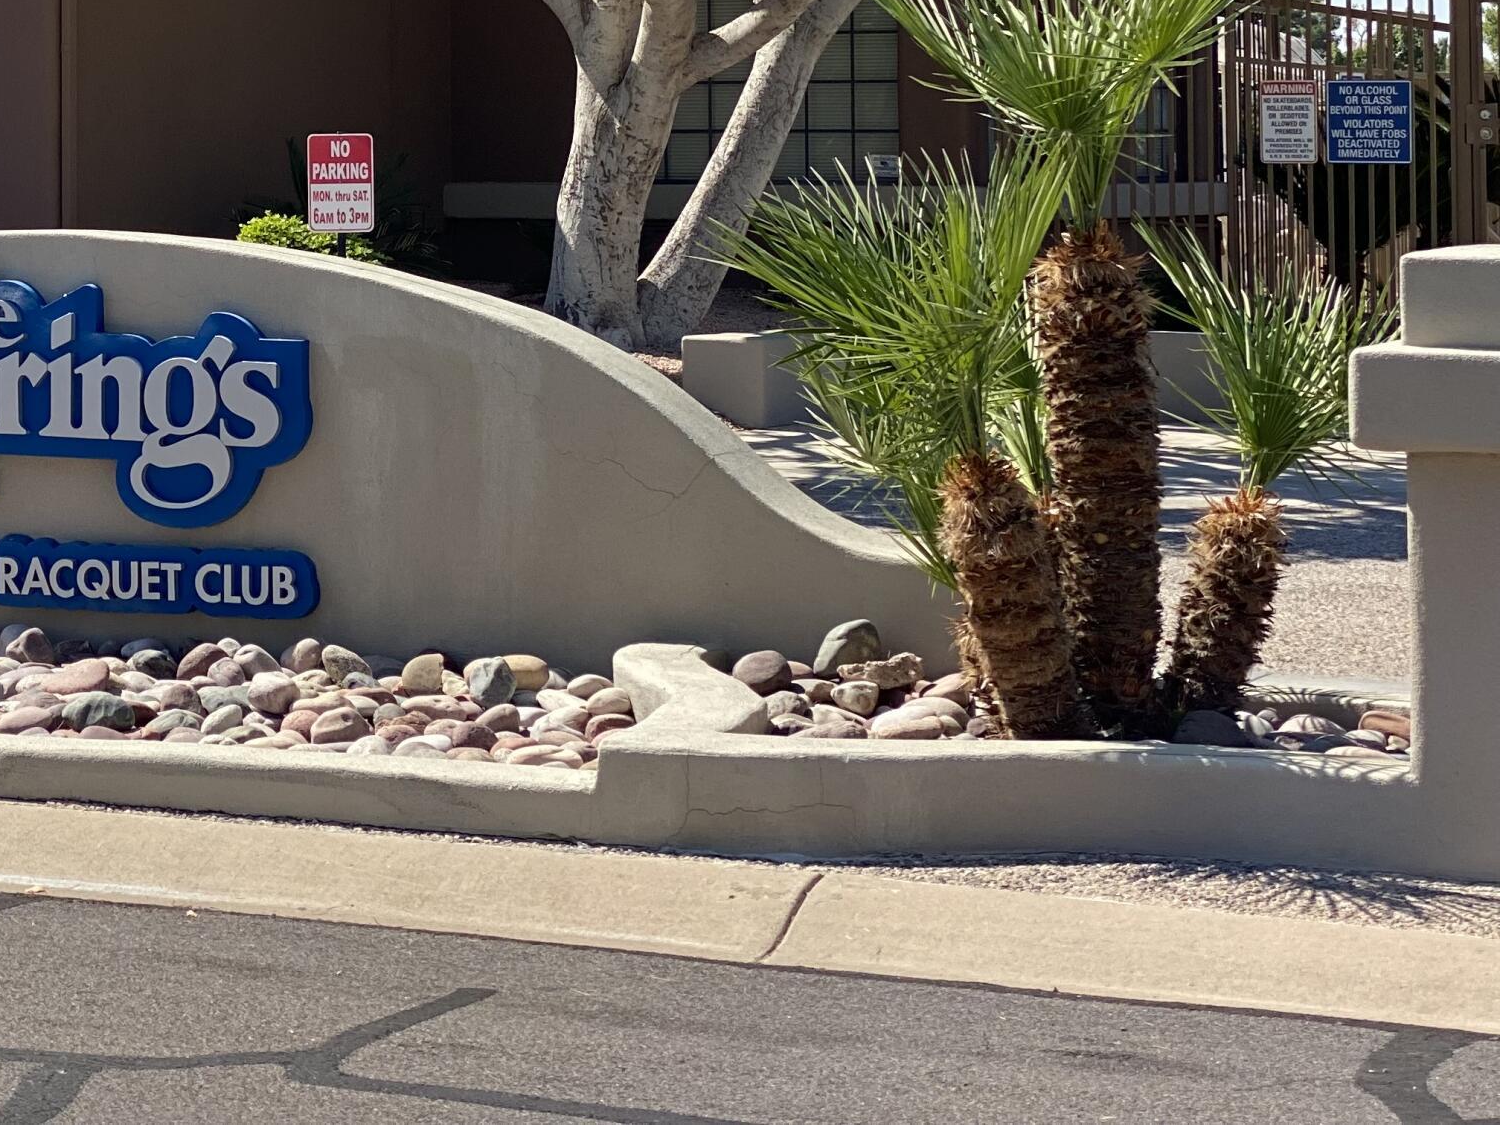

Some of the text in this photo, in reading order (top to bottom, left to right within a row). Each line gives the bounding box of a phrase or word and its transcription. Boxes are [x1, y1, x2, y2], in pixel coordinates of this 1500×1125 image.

[1263, 84, 1314, 94] WARNING
[1339, 86, 1398, 95] NO ALCOHOL
[1345, 96, 1392, 105] OR GLASS
[1330, 106, 1407, 115] BEYOND THIS POINT
[1343, 119, 1394, 128] VIOLATORS
[1331, 129, 1407, 138] WILL HAVE FOBS
[1338, 139, 1400, 148] DEACTIVATED
[331, 140, 351, 157] NO
[1338, 149, 1400, 158] IMMEDIATELY
[312, 162, 369, 180] PARKING
[313, 190, 369, 202] MON. thru SAT.
[337, 208, 346, 223] to
[194, 563, 298, 606] CLUB
